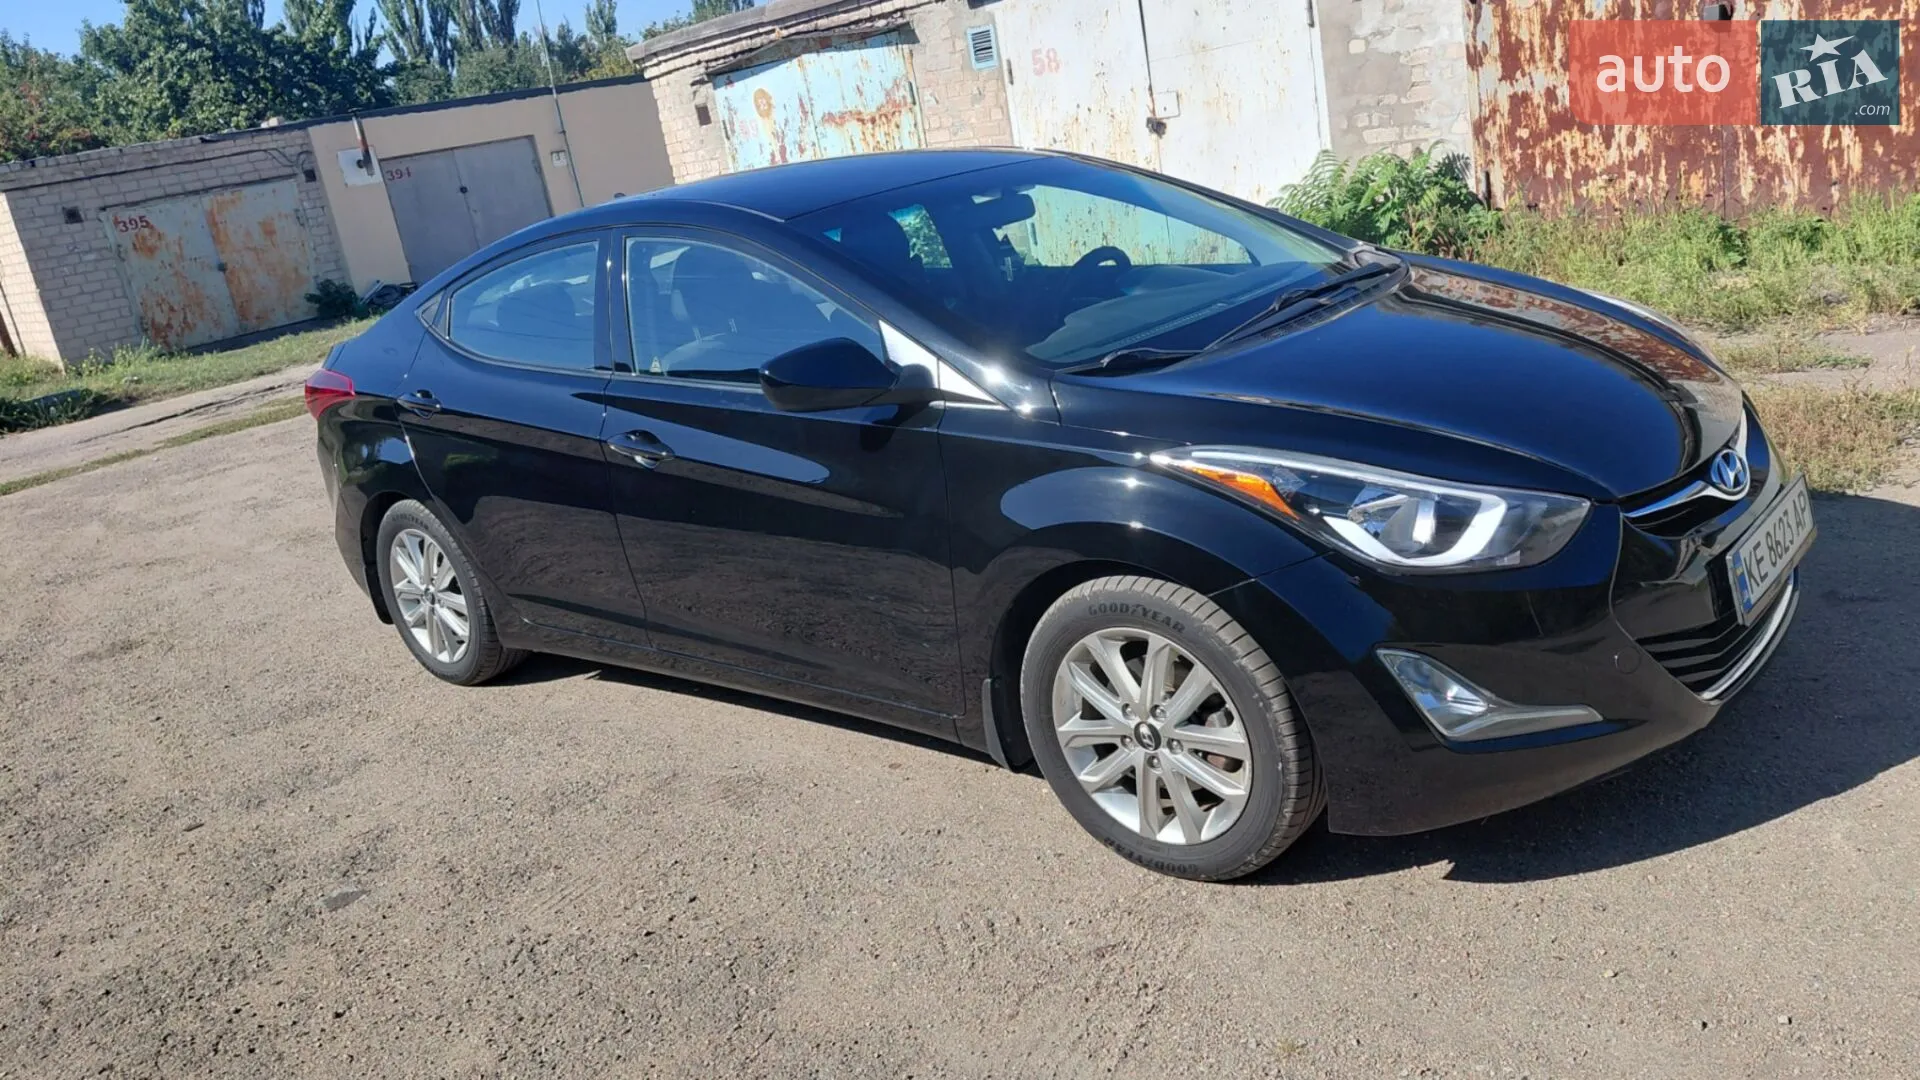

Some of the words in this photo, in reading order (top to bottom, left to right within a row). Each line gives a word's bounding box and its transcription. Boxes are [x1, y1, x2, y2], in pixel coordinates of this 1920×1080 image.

[1031, 48, 1060, 77] 58
[118, 215, 150, 233] 395
[1743, 541, 1769, 595] KE
[1765, 509, 1795, 568] 8623
[1792, 489, 1808, 537] AP
[1088, 602, 1186, 634] GOODYEAR
